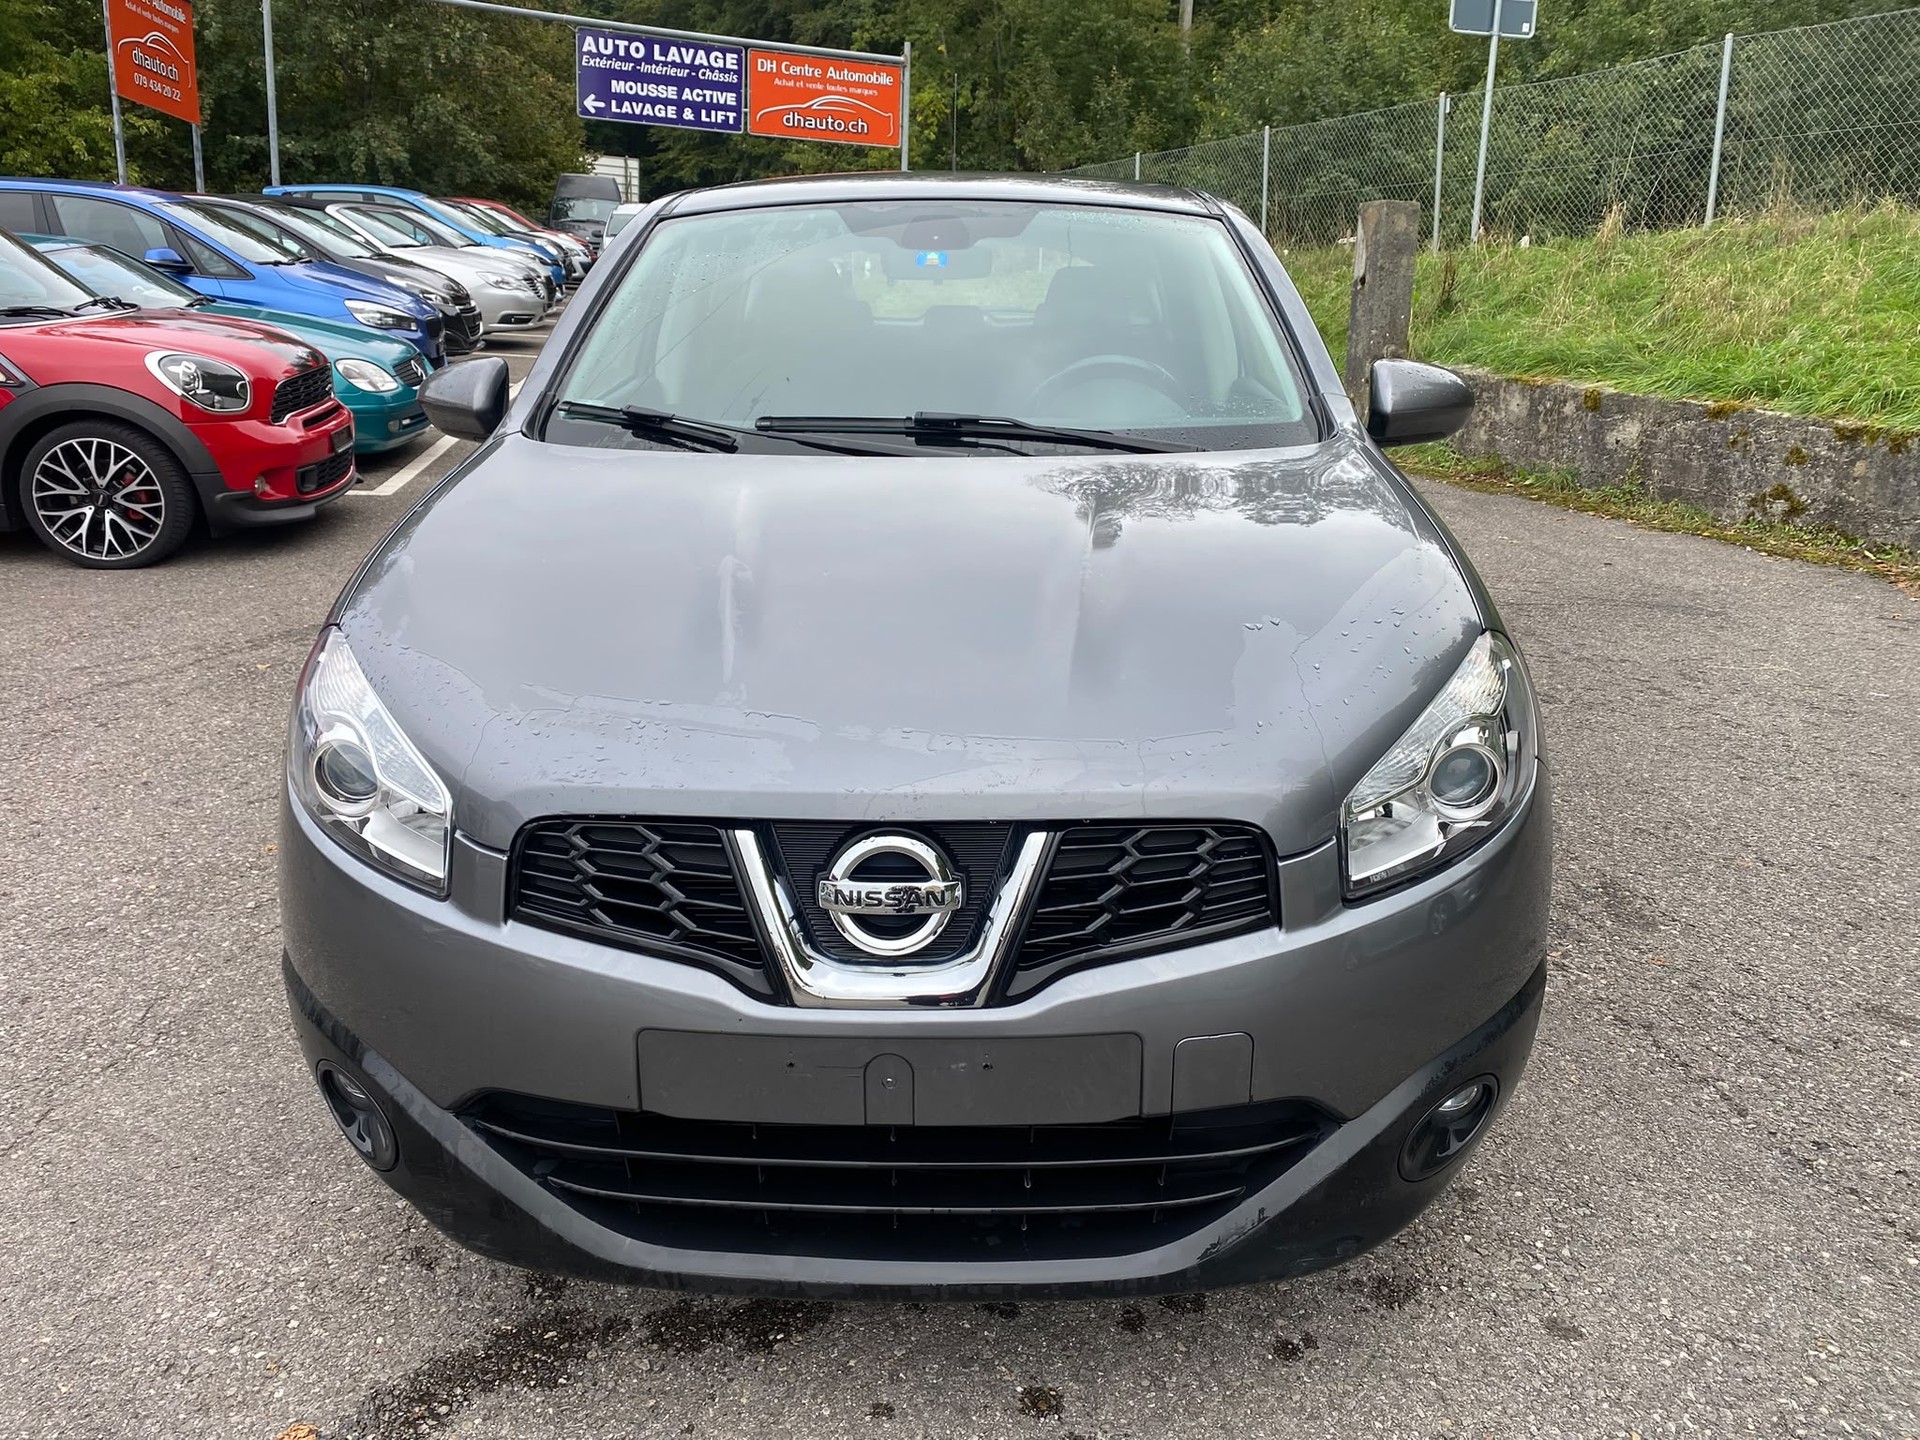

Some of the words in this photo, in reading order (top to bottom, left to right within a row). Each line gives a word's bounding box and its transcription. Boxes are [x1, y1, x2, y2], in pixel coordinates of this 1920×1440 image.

[132, 46, 179, 82] dhauto.ch
[581, 35, 645, 59] AUTO
[653, 44, 739, 70] LAVAGE
[581, 54, 634, 71] Extérieur
[698, 67, 739, 83] Châssis
[757, 58, 777, 73] DH
[781, 61, 822, 78] Centre
[826, 66, 894, 86] Automobile
[134, 72, 148, 88] 079
[149, 79, 162, 94] 434
[162, 84, 171, 97] 20
[172, 88, 182, 102] 22
[611, 79, 678, 99] MOUSSE
[681, 88, 737, 106] ACTIVE
[774, 77, 795, 88] Achat
[796, 80, 804, 88] et
[805, 82, 825, 91] vente
[826, 83, 848, 93] toutes
[849, 86, 878, 97] marques
[611, 99, 678, 119] LAVAGE
[682, 107, 696, 121] &
[701, 109, 737, 125] LIFT
[782, 111, 868, 134] dhauto.ch
[834, 888, 946, 908] NISSAN
